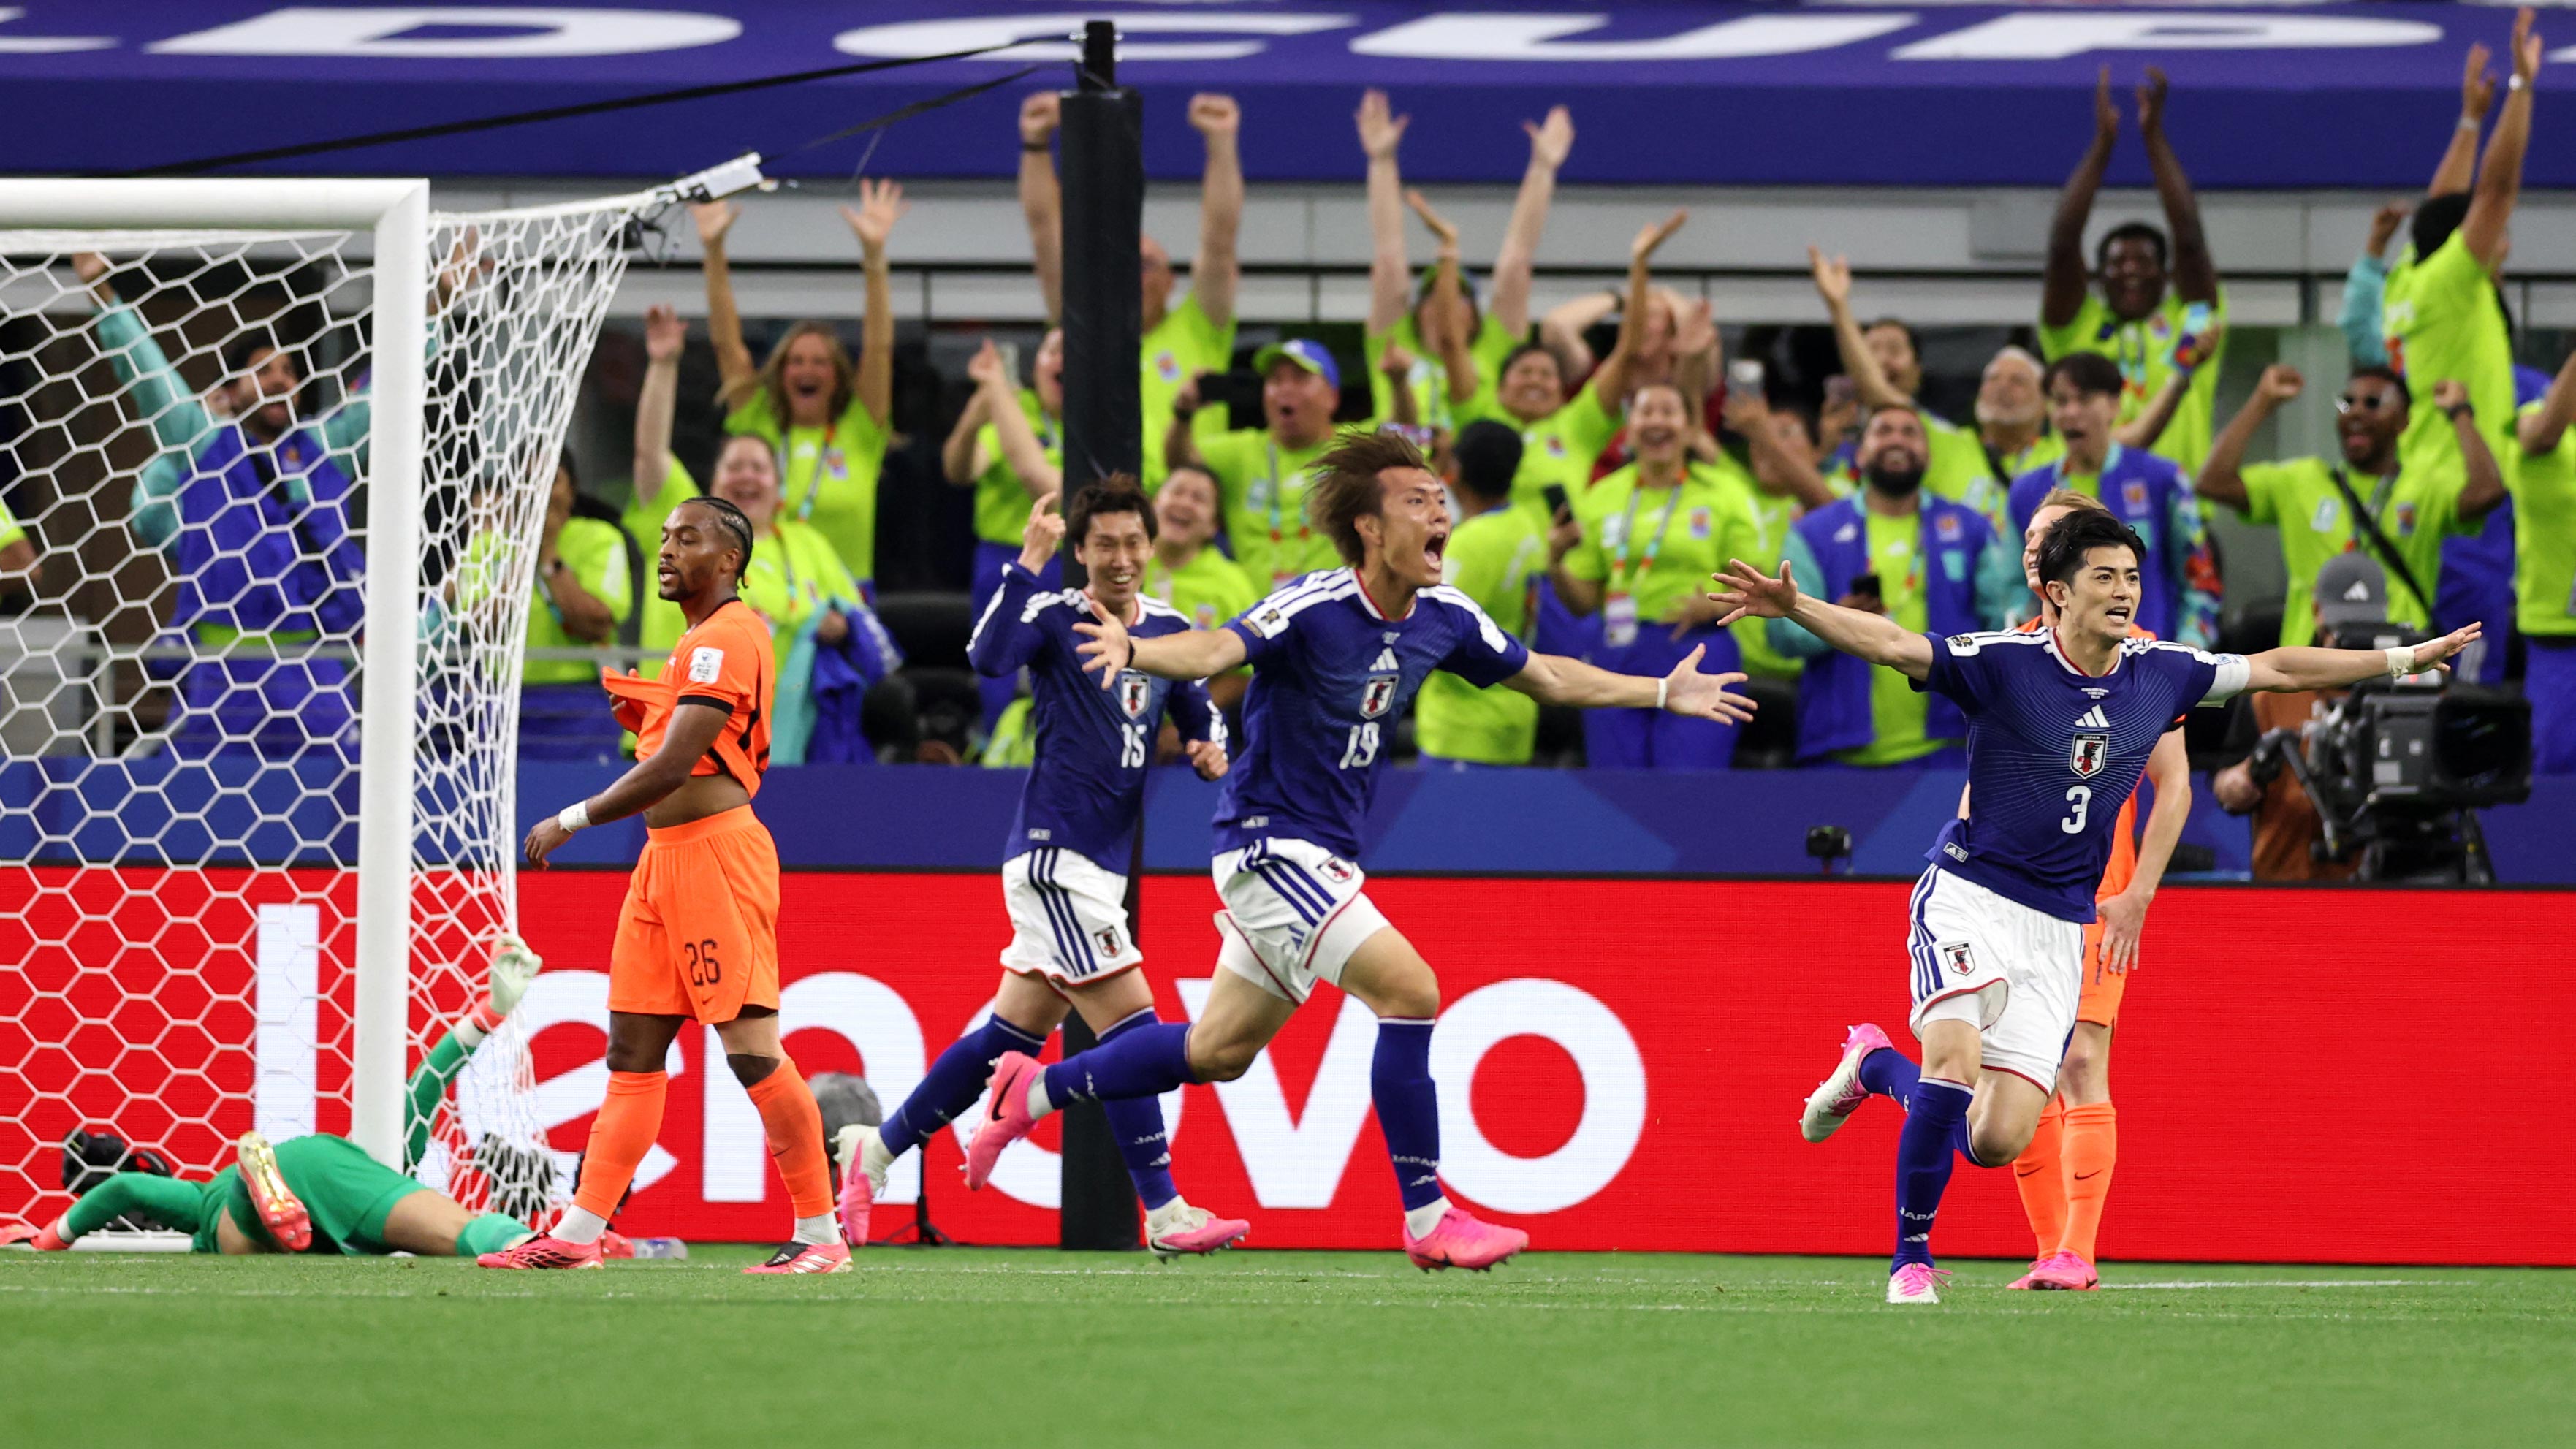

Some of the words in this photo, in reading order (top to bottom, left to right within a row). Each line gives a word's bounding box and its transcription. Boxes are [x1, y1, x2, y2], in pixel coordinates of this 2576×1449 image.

[832, 11, 2443, 61] CUP
[1121, 722, 1147, 768] 15
[1339, 722, 1380, 770] 19
[2061, 785, 2092, 834] 3
[684, 939, 721, 986] 26
